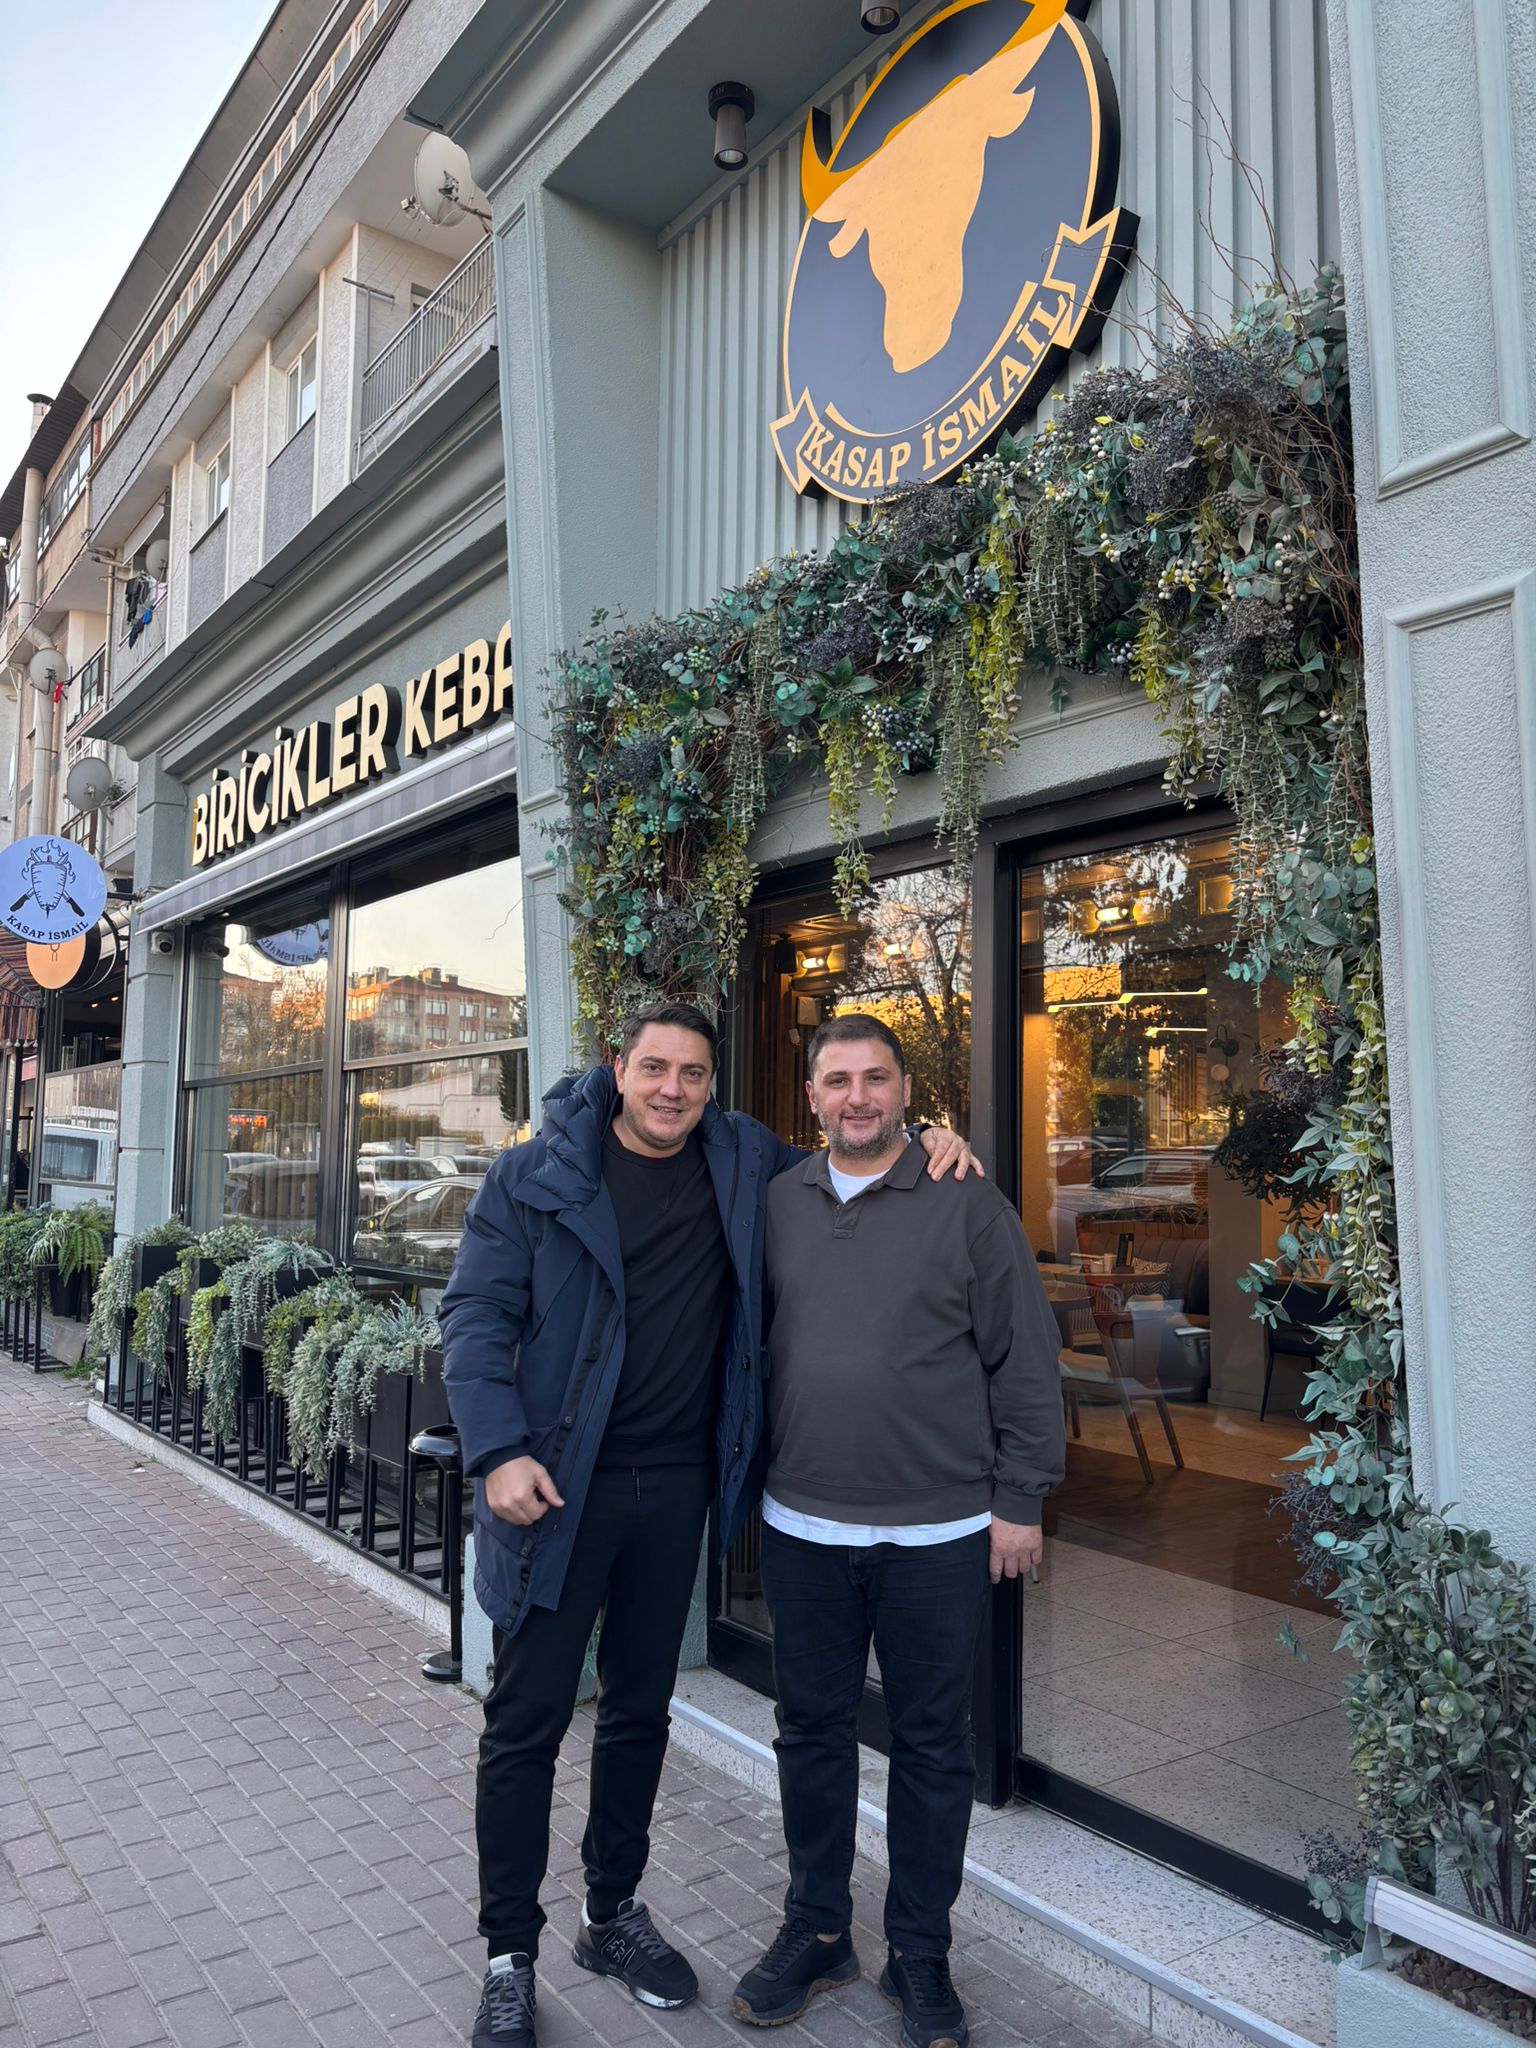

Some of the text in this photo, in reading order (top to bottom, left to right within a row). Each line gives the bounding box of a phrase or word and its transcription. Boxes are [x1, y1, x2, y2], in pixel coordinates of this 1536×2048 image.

[803, 294, 1067, 489] KASAP İSMAİL
[192, 682, 388, 866] BİRİCİKLER
[6, 915, 89, 939] KASAP İSMAİL
